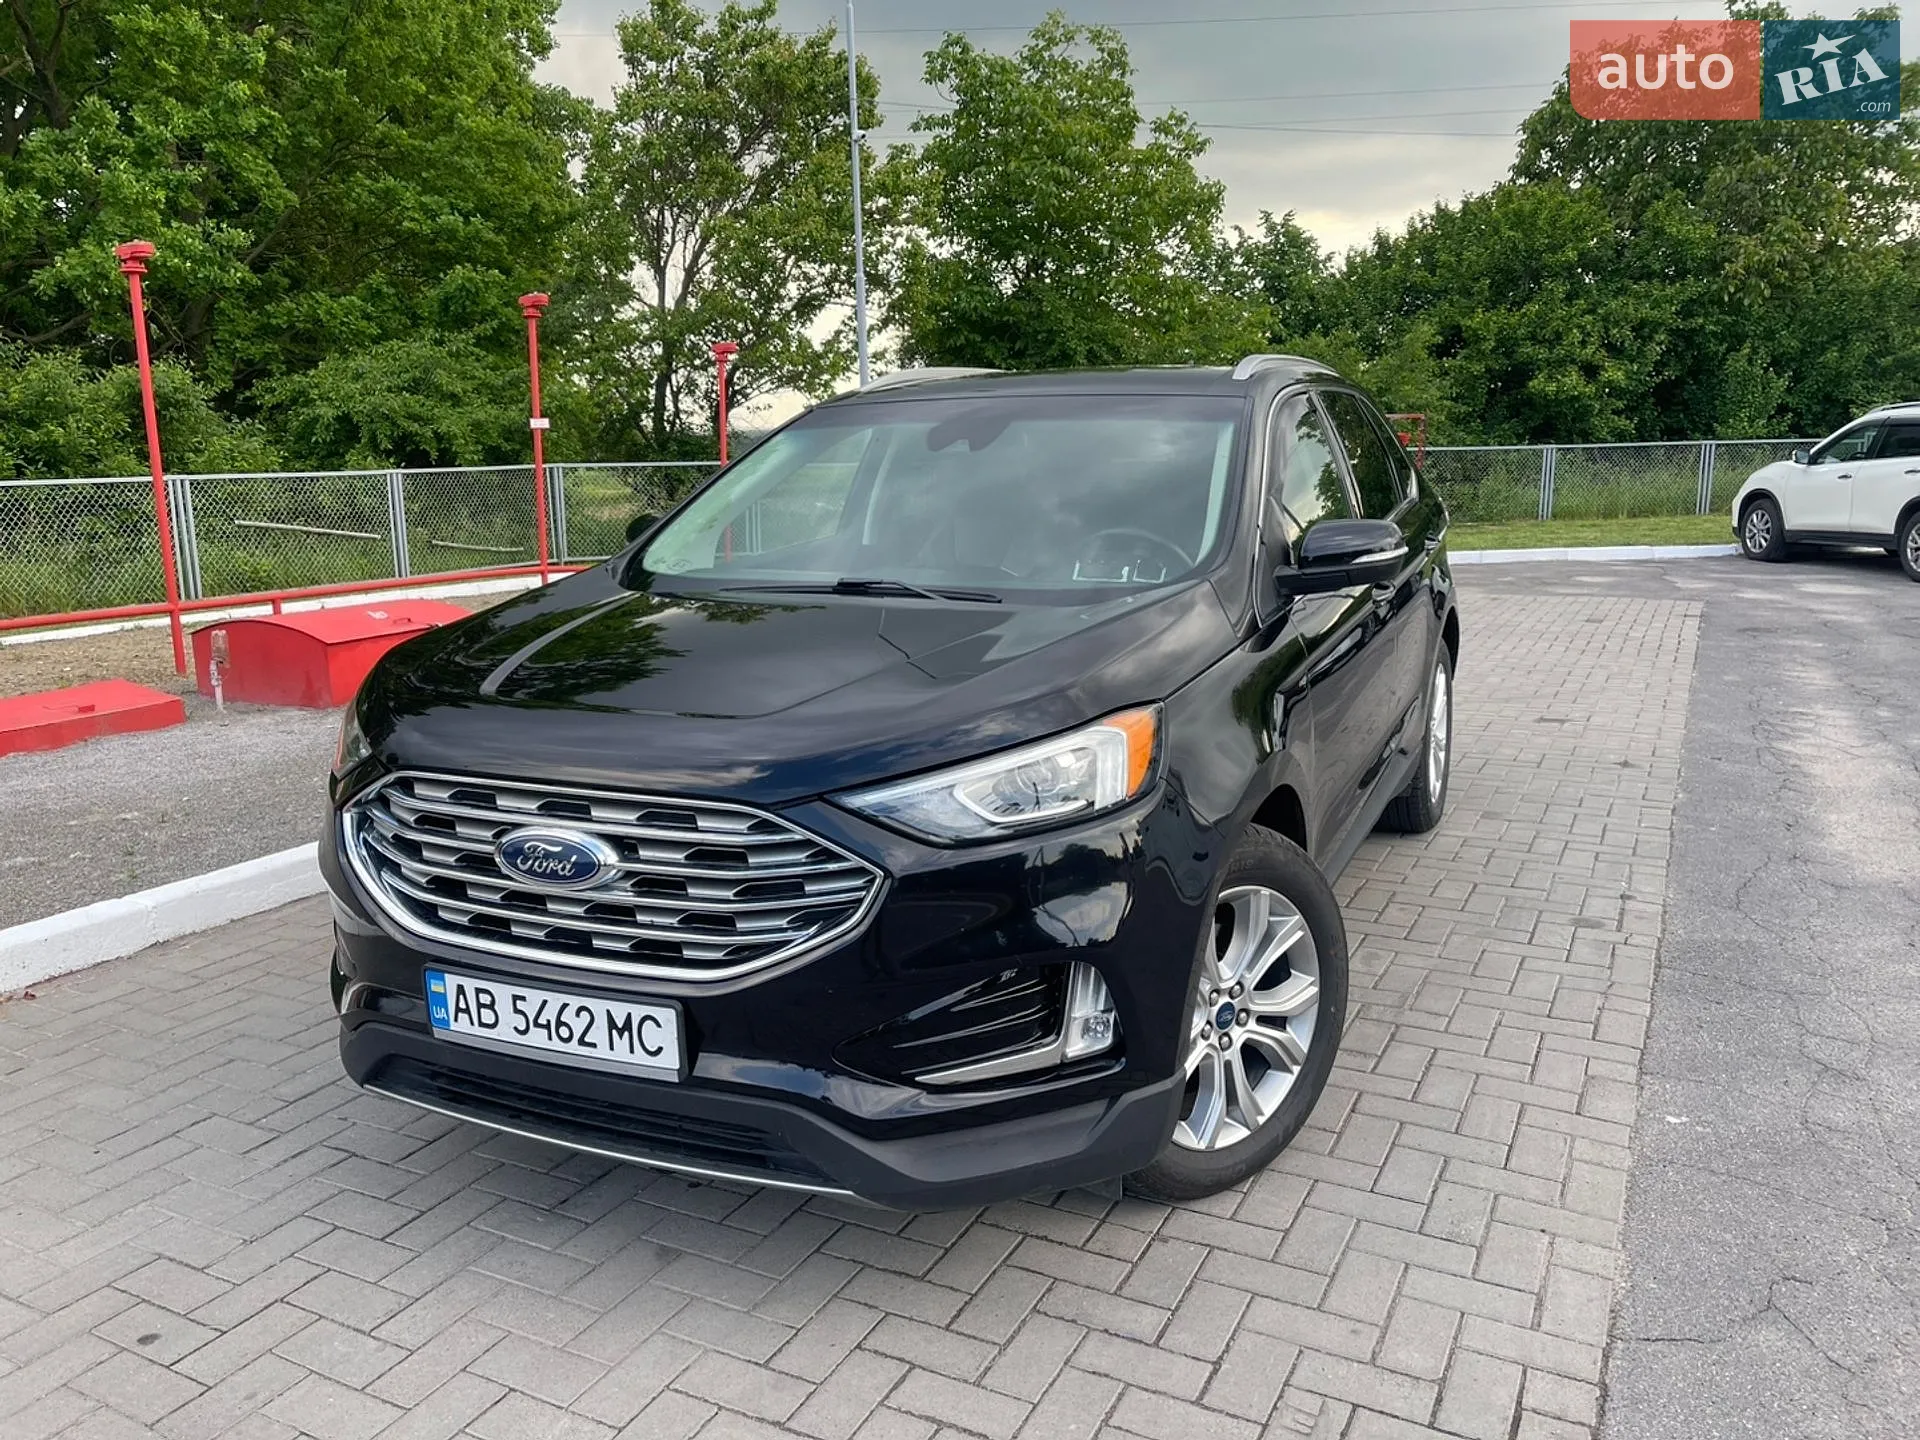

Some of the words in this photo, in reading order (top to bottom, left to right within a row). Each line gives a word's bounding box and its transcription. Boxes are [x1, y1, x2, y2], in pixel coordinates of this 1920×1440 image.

[517, 841, 578, 876] Ford
[433, 1005, 448, 1020] UA
[453, 984, 499, 1030] AB
[511, 994, 598, 1049] 5462
[606, 1008, 664, 1057] MC
